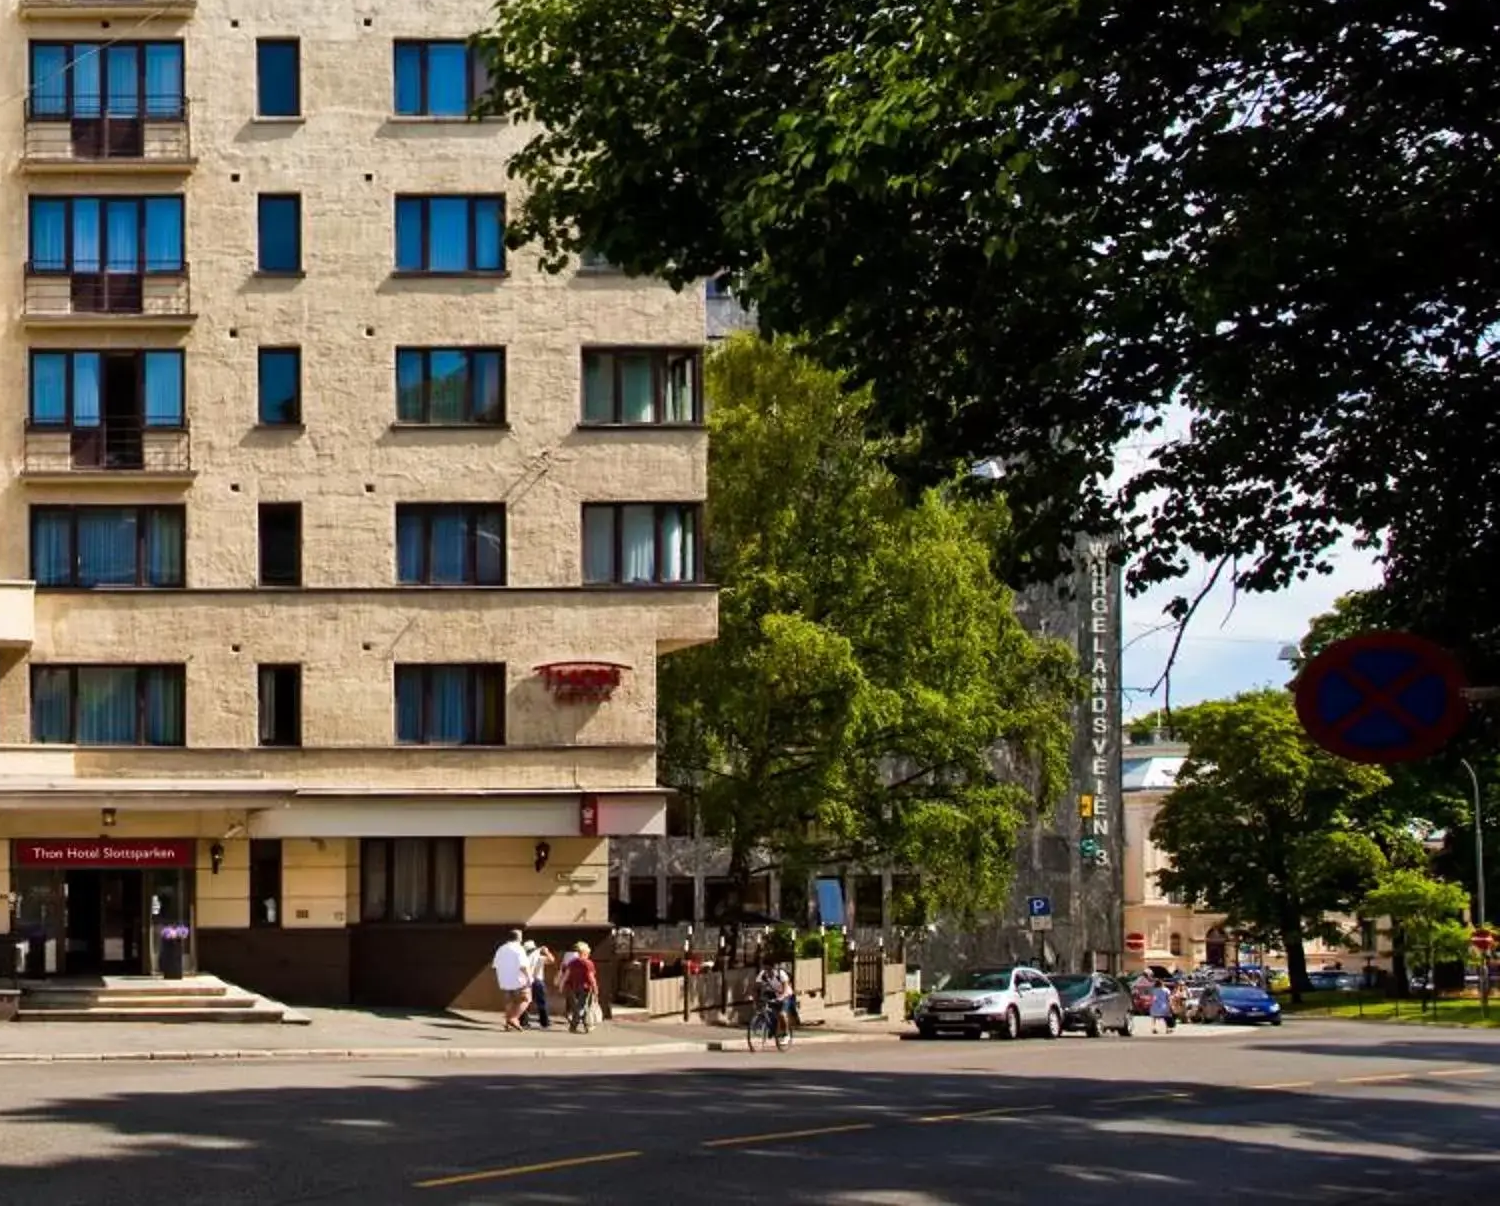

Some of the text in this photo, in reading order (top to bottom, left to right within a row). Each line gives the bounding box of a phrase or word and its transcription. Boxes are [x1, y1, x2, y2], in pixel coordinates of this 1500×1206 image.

[33, 847, 176, 861] Thon Hotel Slottsparken
[1095, 849, 1108, 866] 3
[1033, 899, 1045, 914] P
